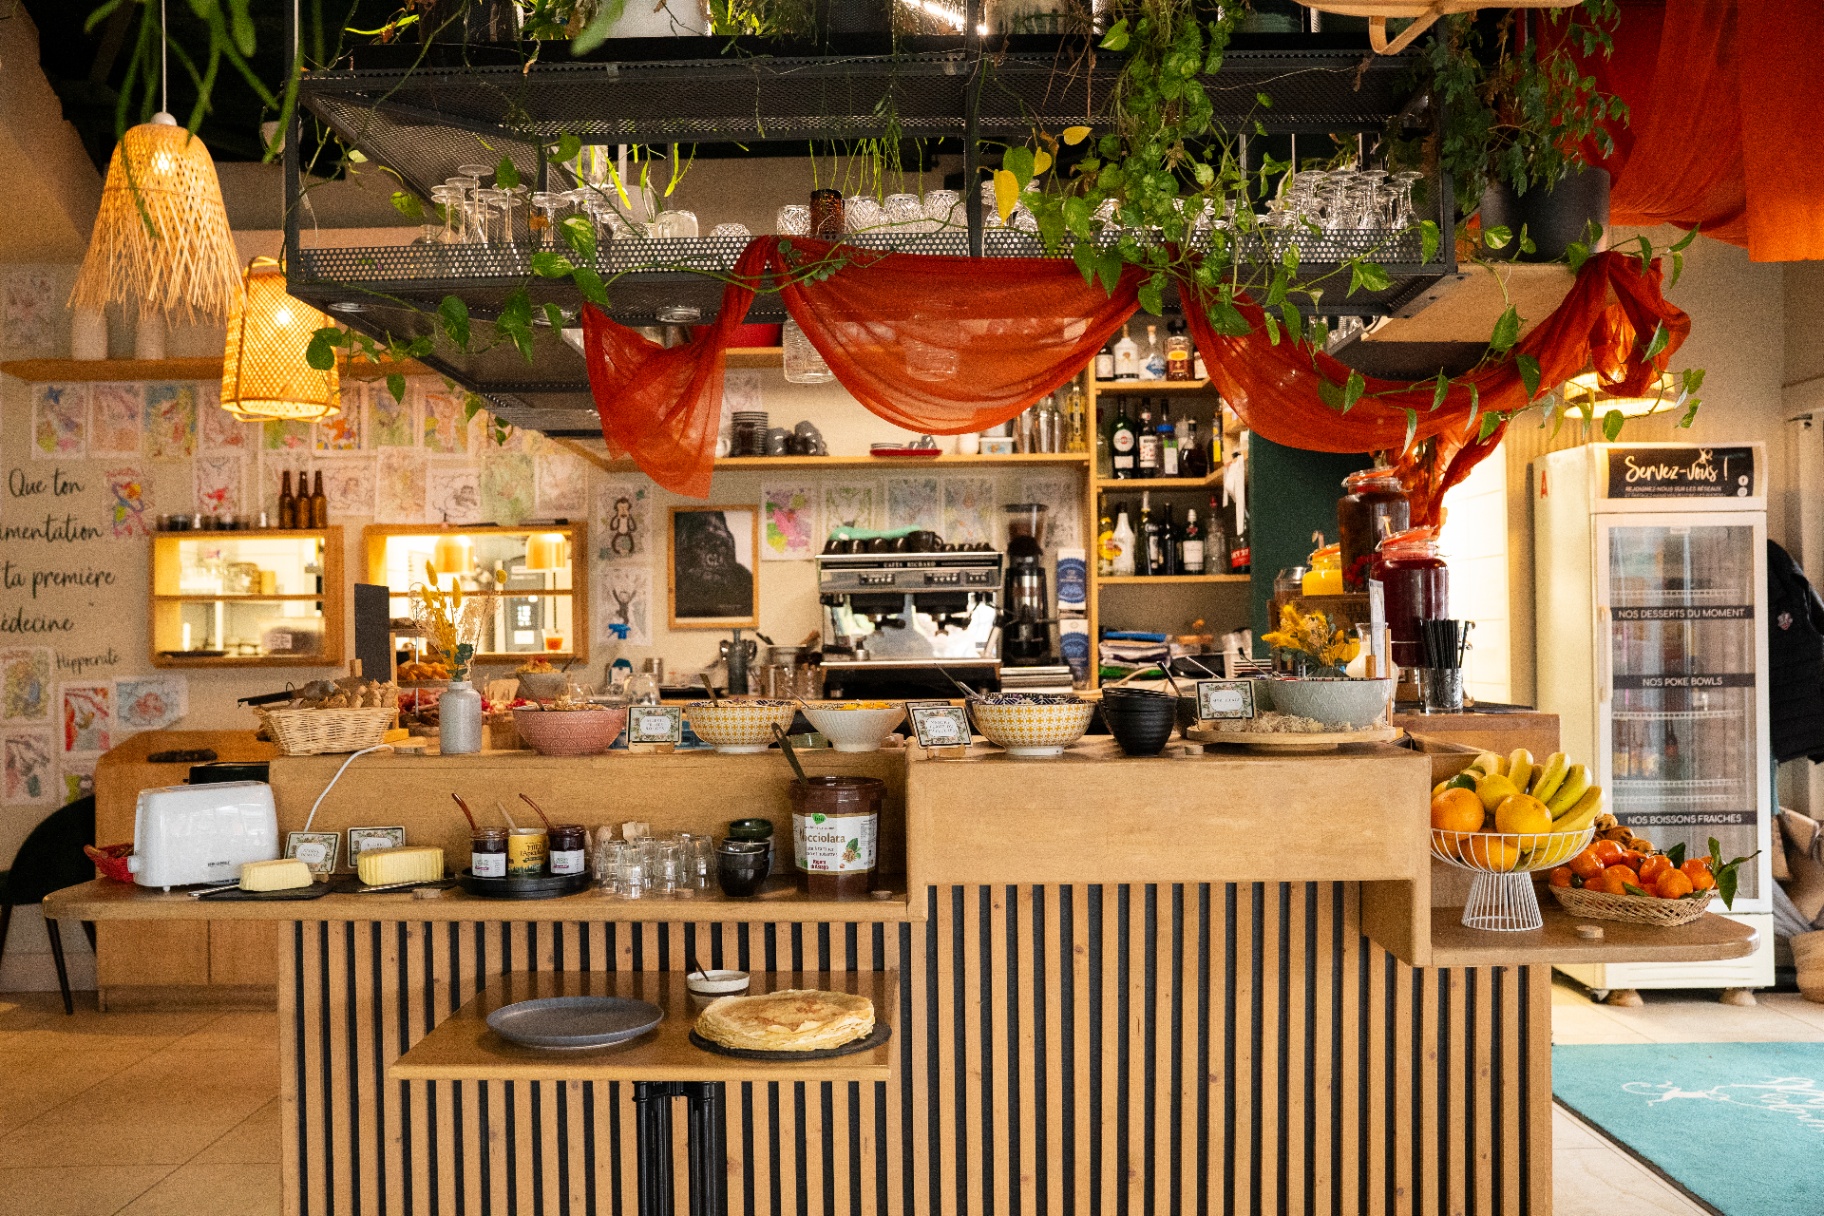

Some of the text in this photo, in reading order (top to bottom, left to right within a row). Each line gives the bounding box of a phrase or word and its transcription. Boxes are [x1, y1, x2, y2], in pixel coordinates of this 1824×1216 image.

[1624, 455, 1728, 482] Servez-vous !
[9, 467, 85, 498] Que ton
[1, 560, 115, 599] ta première
[1640, 610, 1685, 618] DESSERTS
[1687, 609, 1701, 617] DU
[1702, 609, 1745, 617] MOMENT
[1642, 677, 1723, 686] NOS POKE BOWLS
[1627, 814, 1742, 824] NOS BOISSONS FRAICHES
